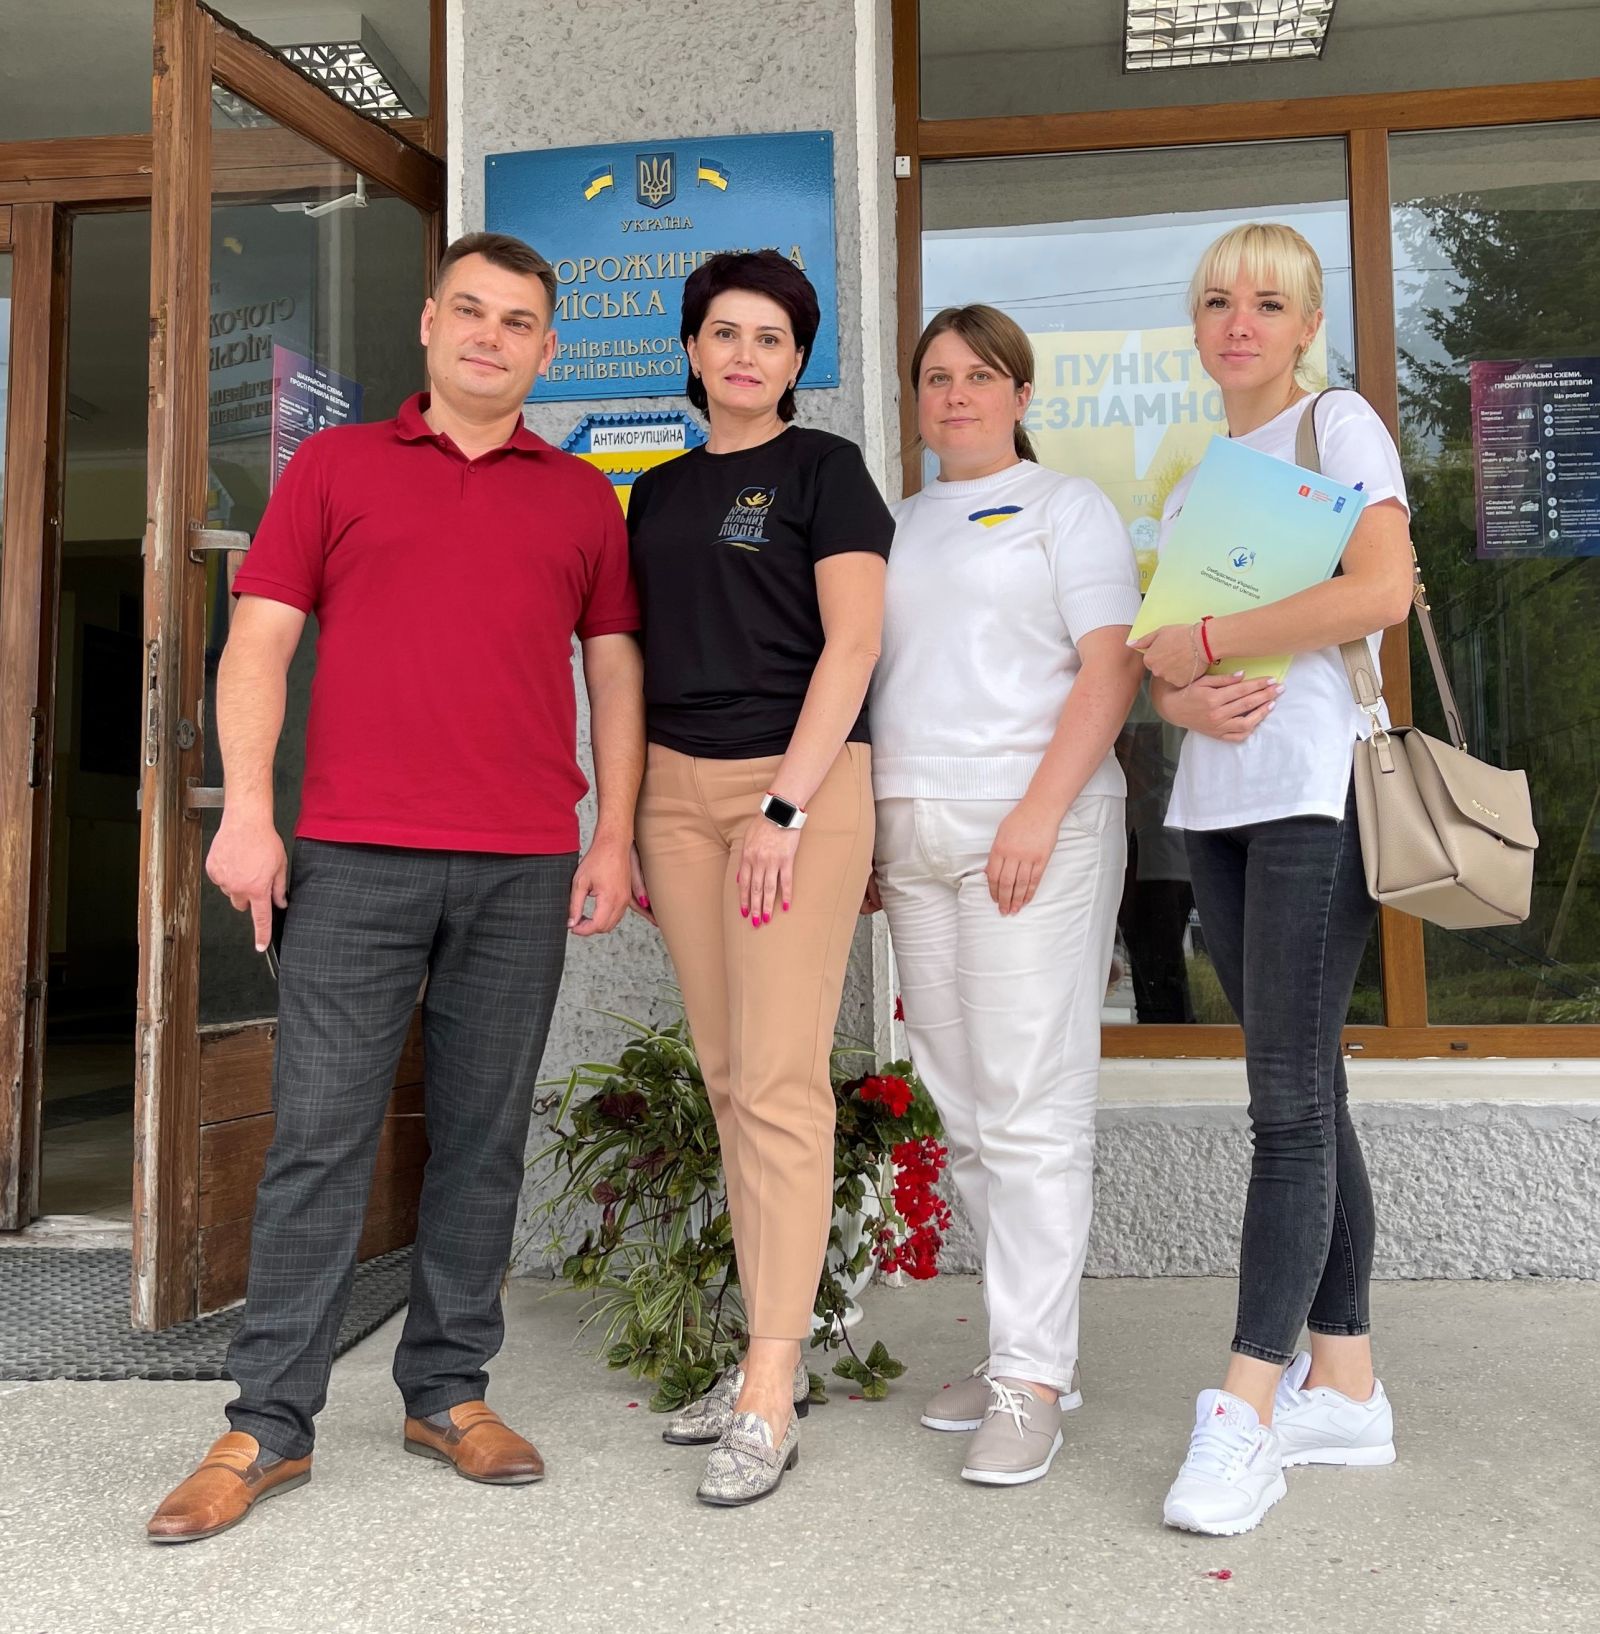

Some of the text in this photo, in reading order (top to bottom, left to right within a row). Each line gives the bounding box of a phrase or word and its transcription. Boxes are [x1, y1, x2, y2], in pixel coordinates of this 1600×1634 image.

[620, 215, 694, 233] УКРАЇНА
[553, 337, 687, 361] РНІВЕЦЬКОГ
[1054, 351, 1208, 388] ПУНКТ
[1504, 371, 1582, 381] ШАХРАЙСЬКІ СХЕМИ.
[1494, 379, 1593, 390] ПРОСТІ ПРАВИЛА БЕЗПЕКИ
[1565, 392, 1590, 400] робити?
[1026, 389, 1226, 432] ЕЗЛАМНО
[593, 428, 684, 446] АНТИКОРУПЦІЙНА
[723, 515, 766, 527] ВІЛЬНИХ
[718, 523, 764, 538] ЛЮДЕЙ
